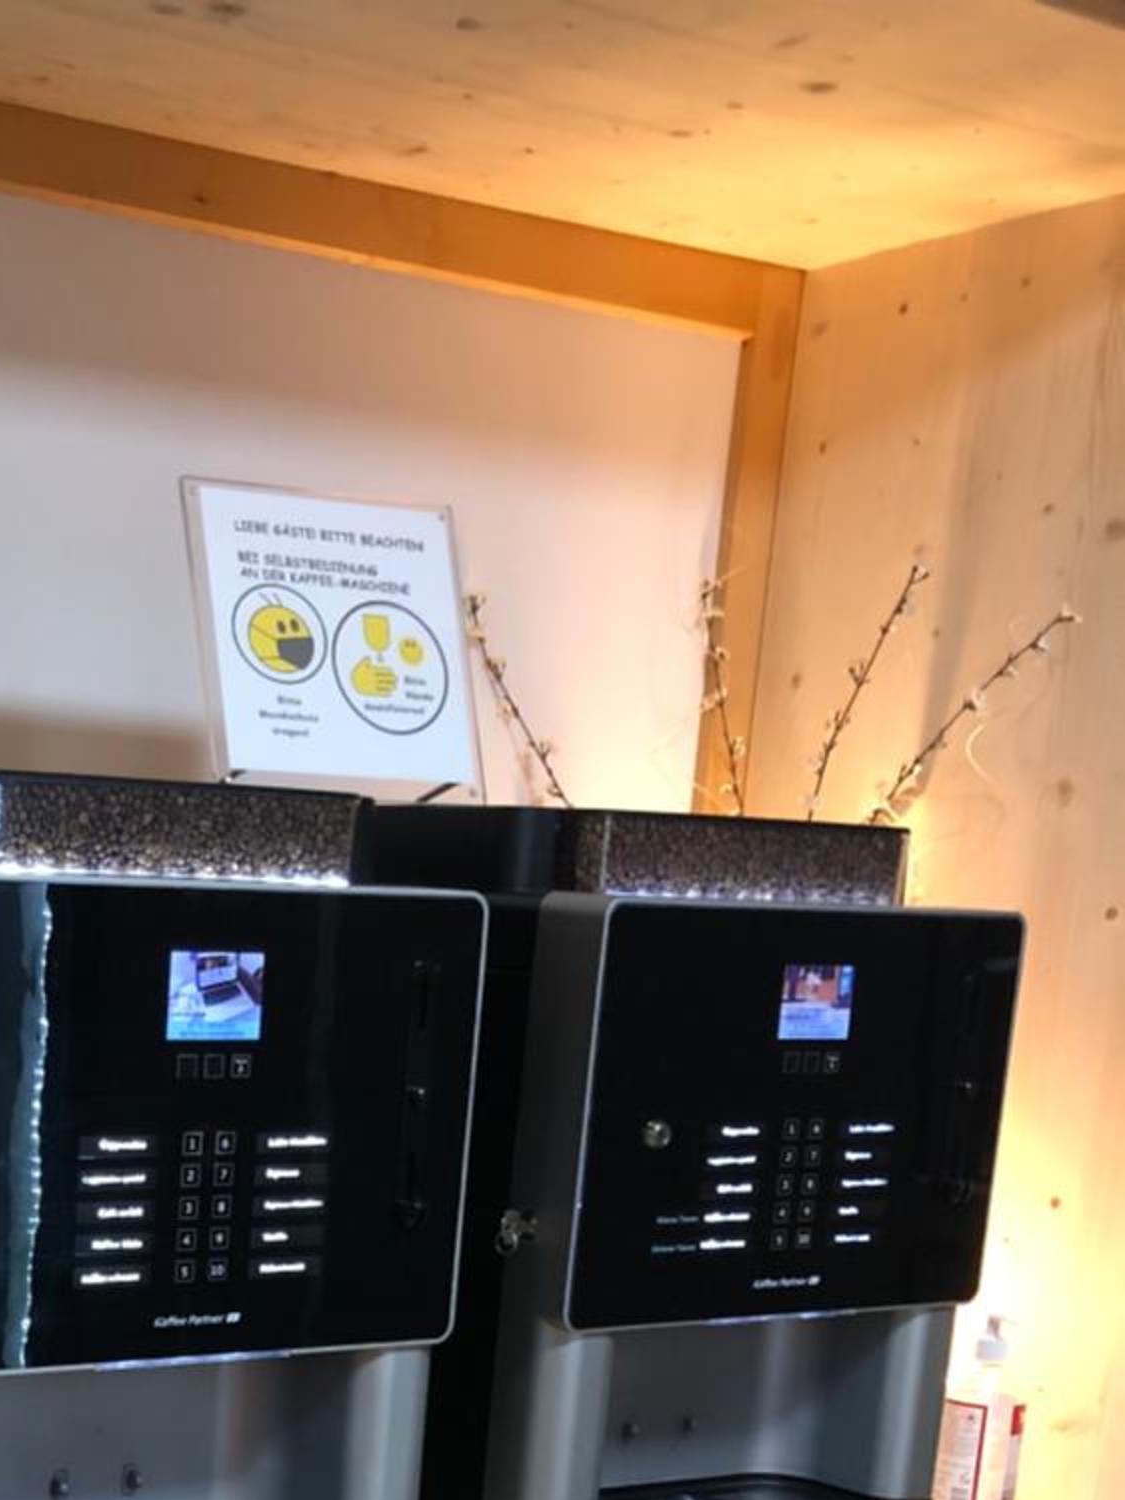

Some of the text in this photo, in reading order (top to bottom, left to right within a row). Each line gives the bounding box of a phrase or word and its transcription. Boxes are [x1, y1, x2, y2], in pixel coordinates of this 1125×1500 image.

[234, 519, 268, 534] LIEBE
[320, 528, 355, 545] BITTE
[238, 550, 259, 564] BEI
[240, 566, 260, 580] AN
[262, 568, 285, 582] DER
